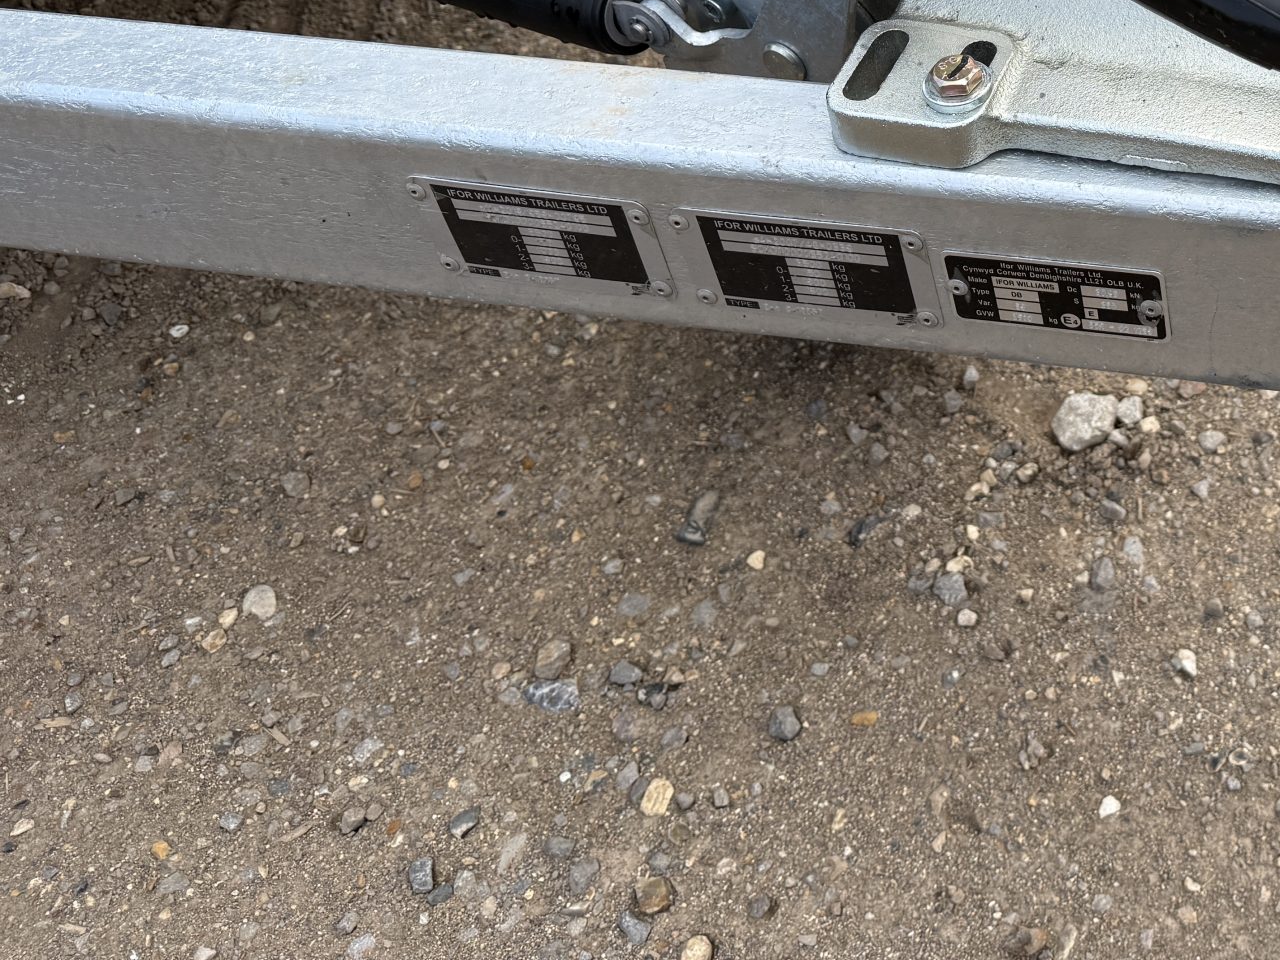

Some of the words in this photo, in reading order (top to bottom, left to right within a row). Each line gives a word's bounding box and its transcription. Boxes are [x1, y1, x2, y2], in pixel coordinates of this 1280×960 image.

[447, 189, 474, 200] IFOR
[474, 191, 528, 206] WILLIAMS
[529, 198, 585, 212] TRAILERS
[586, 204, 608, 215] LTD
[562, 231, 577, 242] kg
[714, 219, 741, 231] IFOR
[742, 222, 799, 236] WILLIAMS
[800, 228, 858, 242] TRAILERS
[860, 234, 883, 244] LTD
[566, 241, 581, 252] kg
[570, 250, 584, 261] kg
[574, 259, 588, 270] kg
[831, 262, 846, 273] kg
[1017, 263, 1051, 273] Williams
[1054, 267, 1085, 277] Trailers
[577, 268, 592, 278] kg
[835, 271, 849, 282] kg
[962, 265, 994, 275] Cynwyd
[996, 268, 1027, 278] Corwen
[1029, 272, 1082, 283] Denbighshire
[838, 280, 851, 291] kg
[1016, 281, 1055, 290] WILLIAMS
[840, 289, 854, 300] kg
[971, 288, 990, 296] Type
[843, 299, 856, 309] kg
